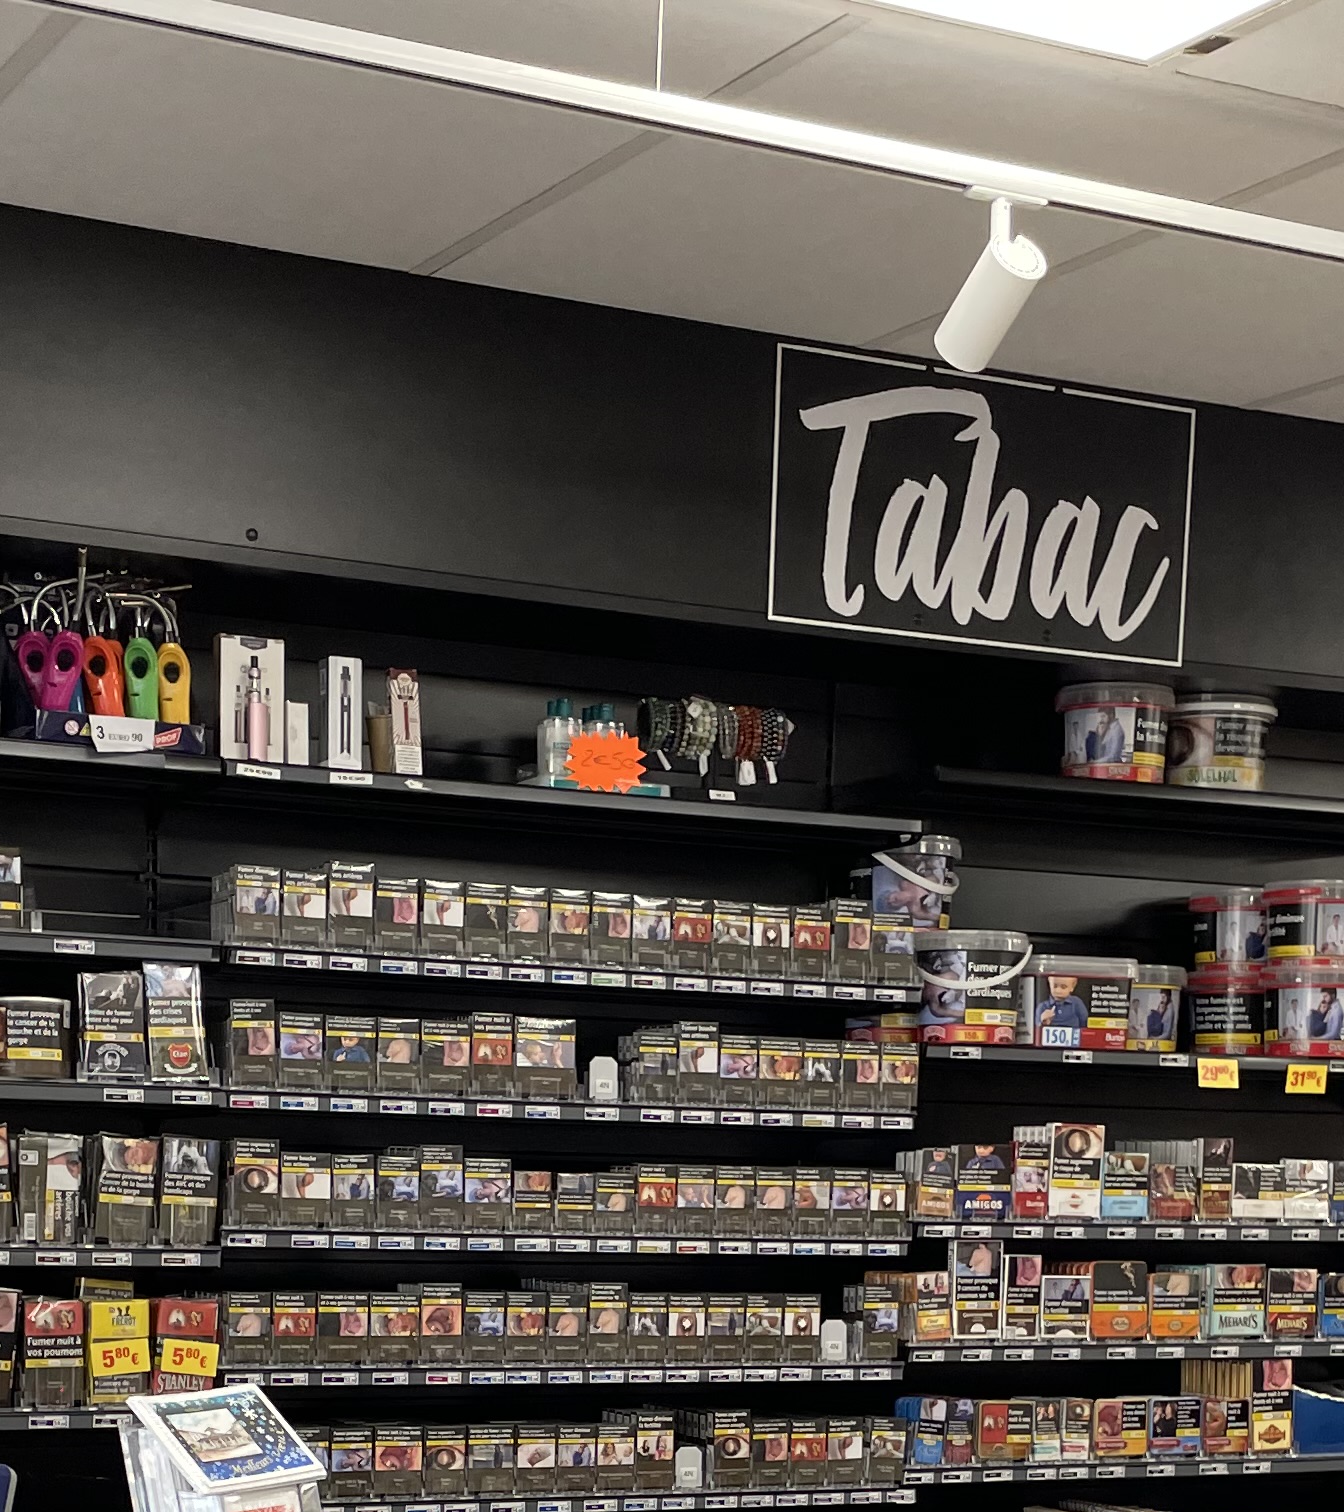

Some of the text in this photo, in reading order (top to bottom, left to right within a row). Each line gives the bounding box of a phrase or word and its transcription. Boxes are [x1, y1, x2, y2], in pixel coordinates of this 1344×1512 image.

[799, 386, 1170, 642] Tabac
[95, 725, 105, 739] 3
[131, 732, 143, 743] 90
[968, 961, 999, 974] Fumer
[964, 1199, 1003, 1211] AMIGOS
[27, 1335, 54, 1347] Fumer
[56, 1334, 73, 1347] nuit
[27, 1345, 83, 1359] vos poumons
[156, 1372, 206, 1393] STANLEY
